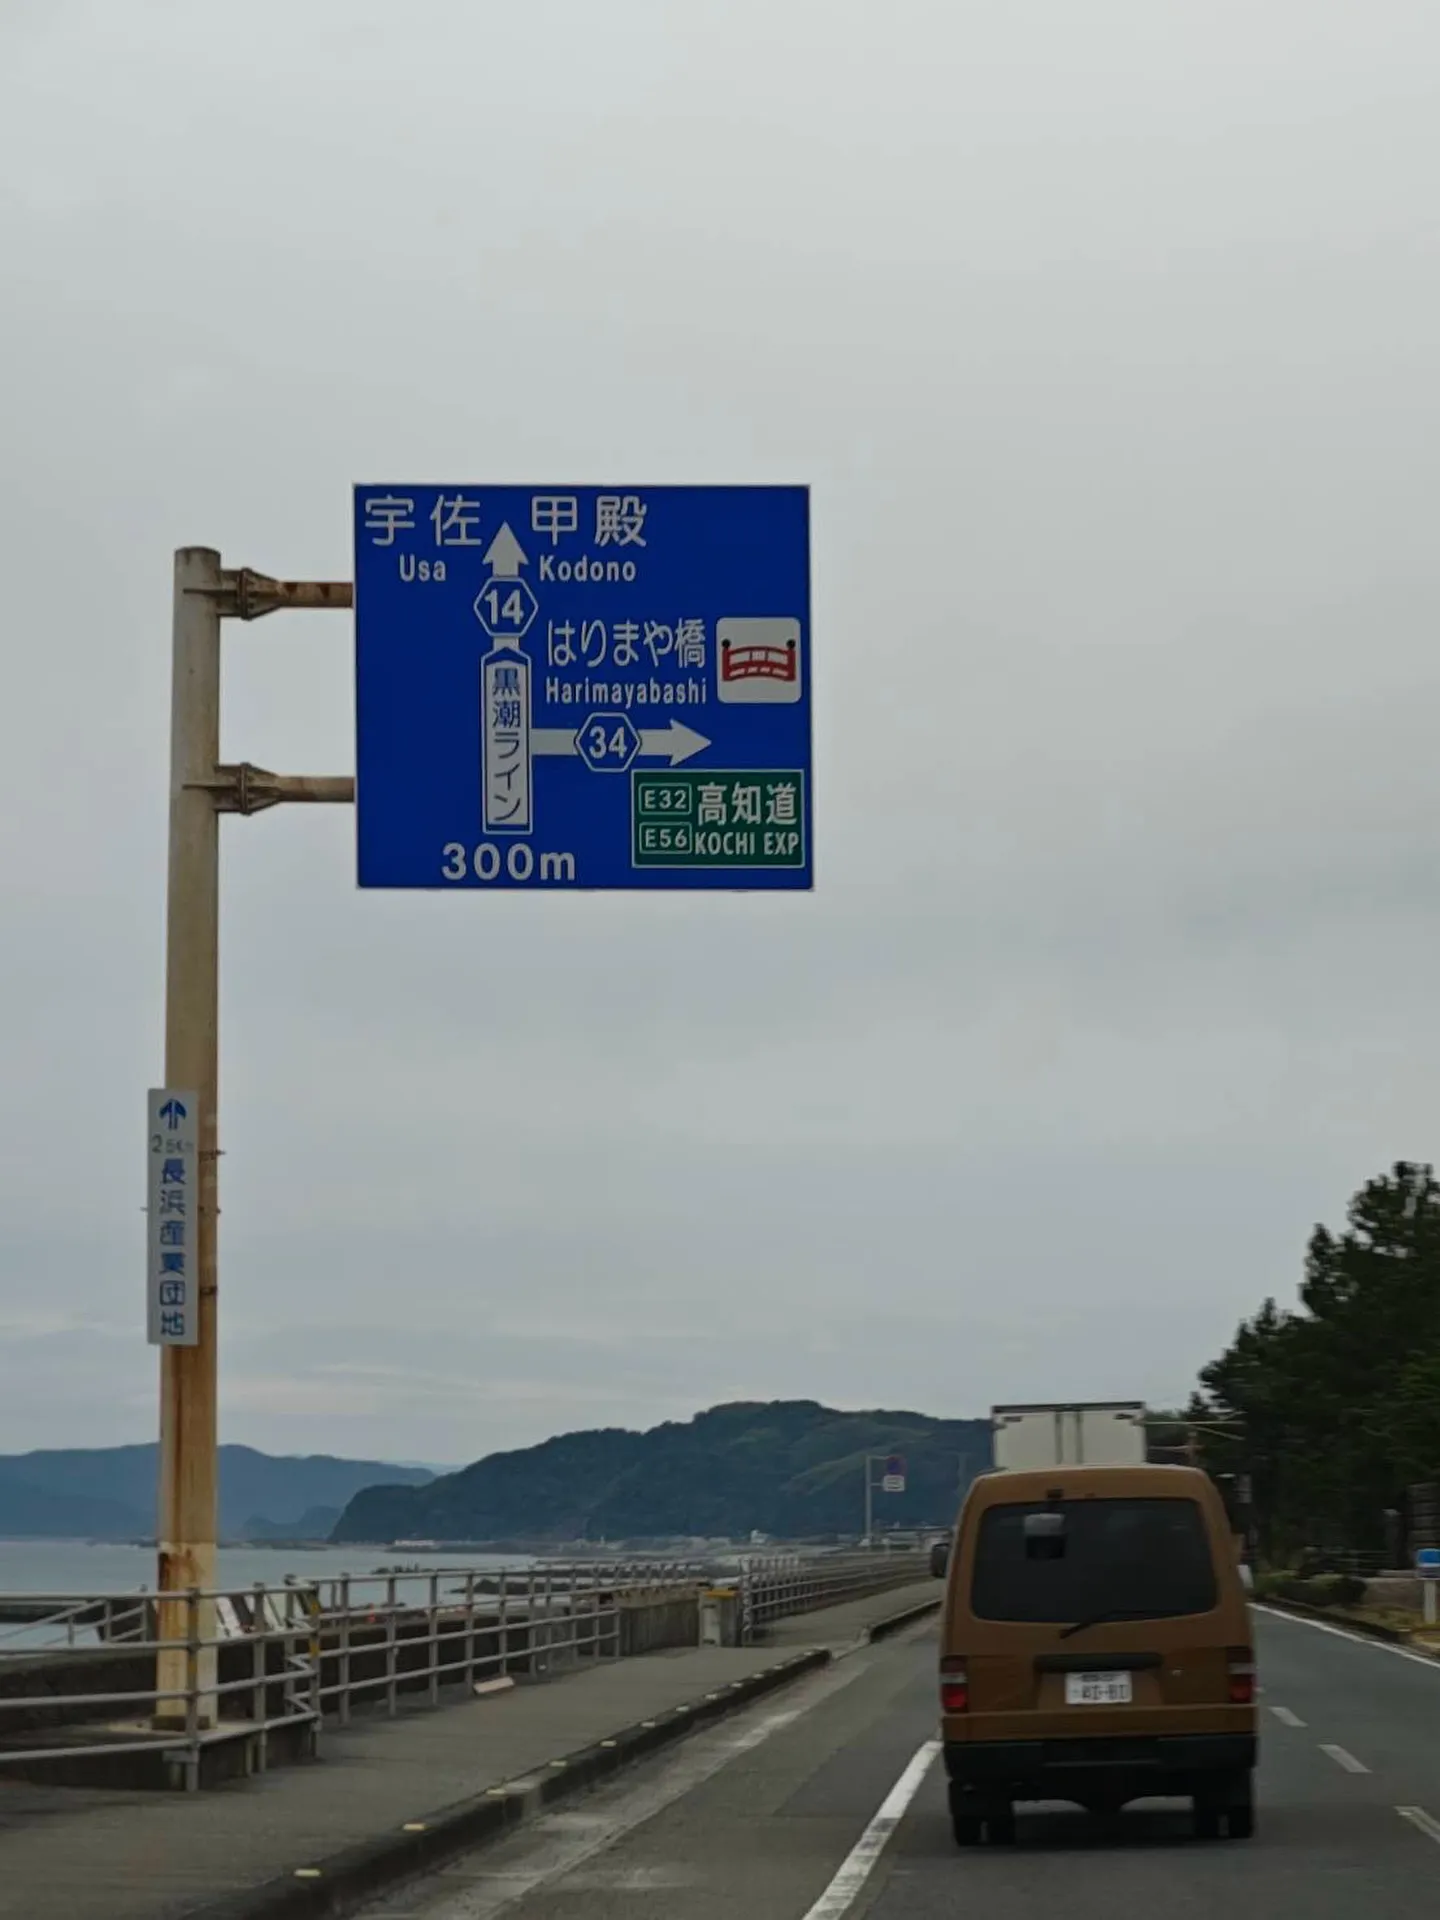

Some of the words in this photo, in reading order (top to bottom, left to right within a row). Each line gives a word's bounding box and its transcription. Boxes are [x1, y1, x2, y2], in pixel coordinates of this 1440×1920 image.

[365, 495, 482, 547] 宇佐
[531, 495, 648, 547] 甲殿
[399, 555, 447, 583] Usa
[540, 555, 637, 583] Kodono
[485, 591, 524, 624] 14
[547, 619, 707, 668] はりまや橋
[546, 679, 708, 708] Harimayabashi
[492, 666, 522, 822] 黒潮ライン
[589, 726, 627, 759] 34
[644, 789, 687, 809] E32
[697, 782, 797, 825] 高知道
[645, 828, 689, 849] E56
[695, 833, 755, 855] KOCHI
[764, 833, 800, 856] EXP
[442, 844, 576, 881] 300m
